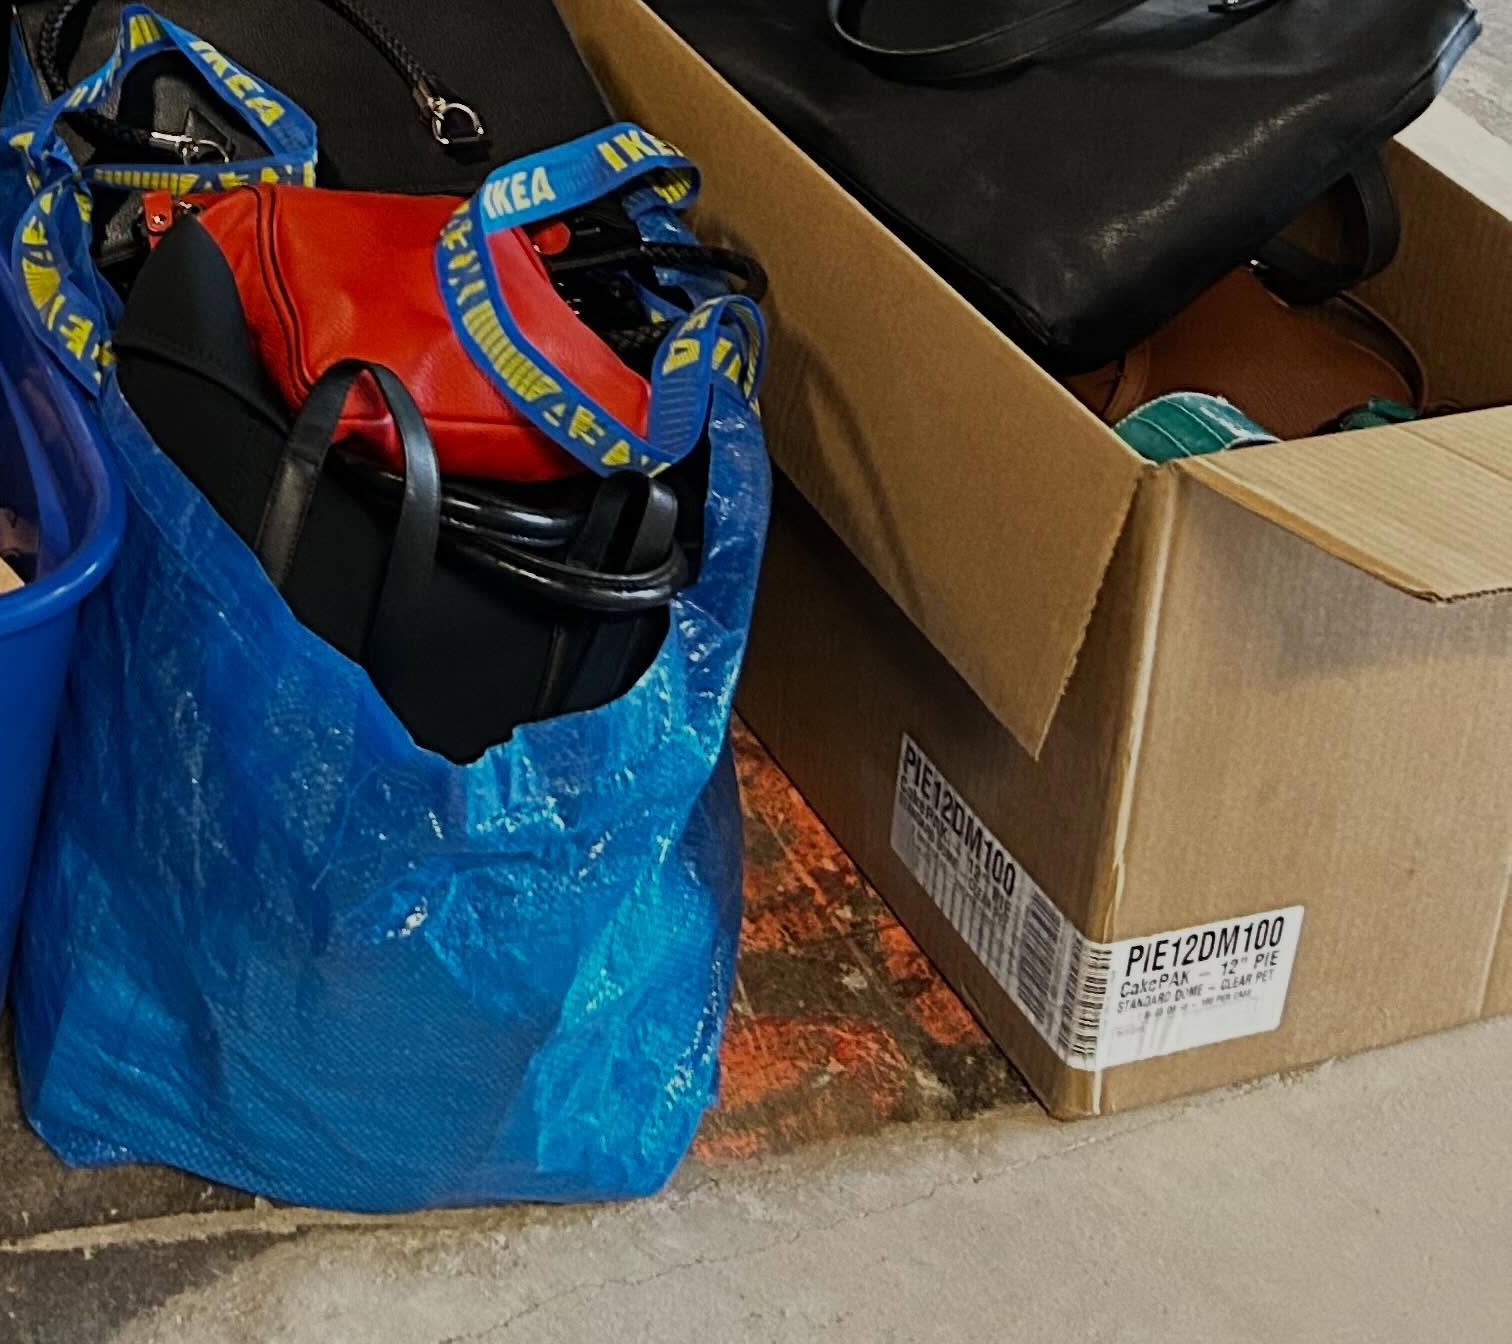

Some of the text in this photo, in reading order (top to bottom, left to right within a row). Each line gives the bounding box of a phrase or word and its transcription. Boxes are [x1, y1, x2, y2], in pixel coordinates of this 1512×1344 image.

[189, 40, 285, 126] IKEA
[483, 166, 556, 219] IKEA
[904, 743, 1016, 896] PIE12DM100
[1120, 970, 1192, 998] CakePAK
[1253, 950, 1280, 969] PIE
[1125, 916, 1285, 977] PIE12DM100
